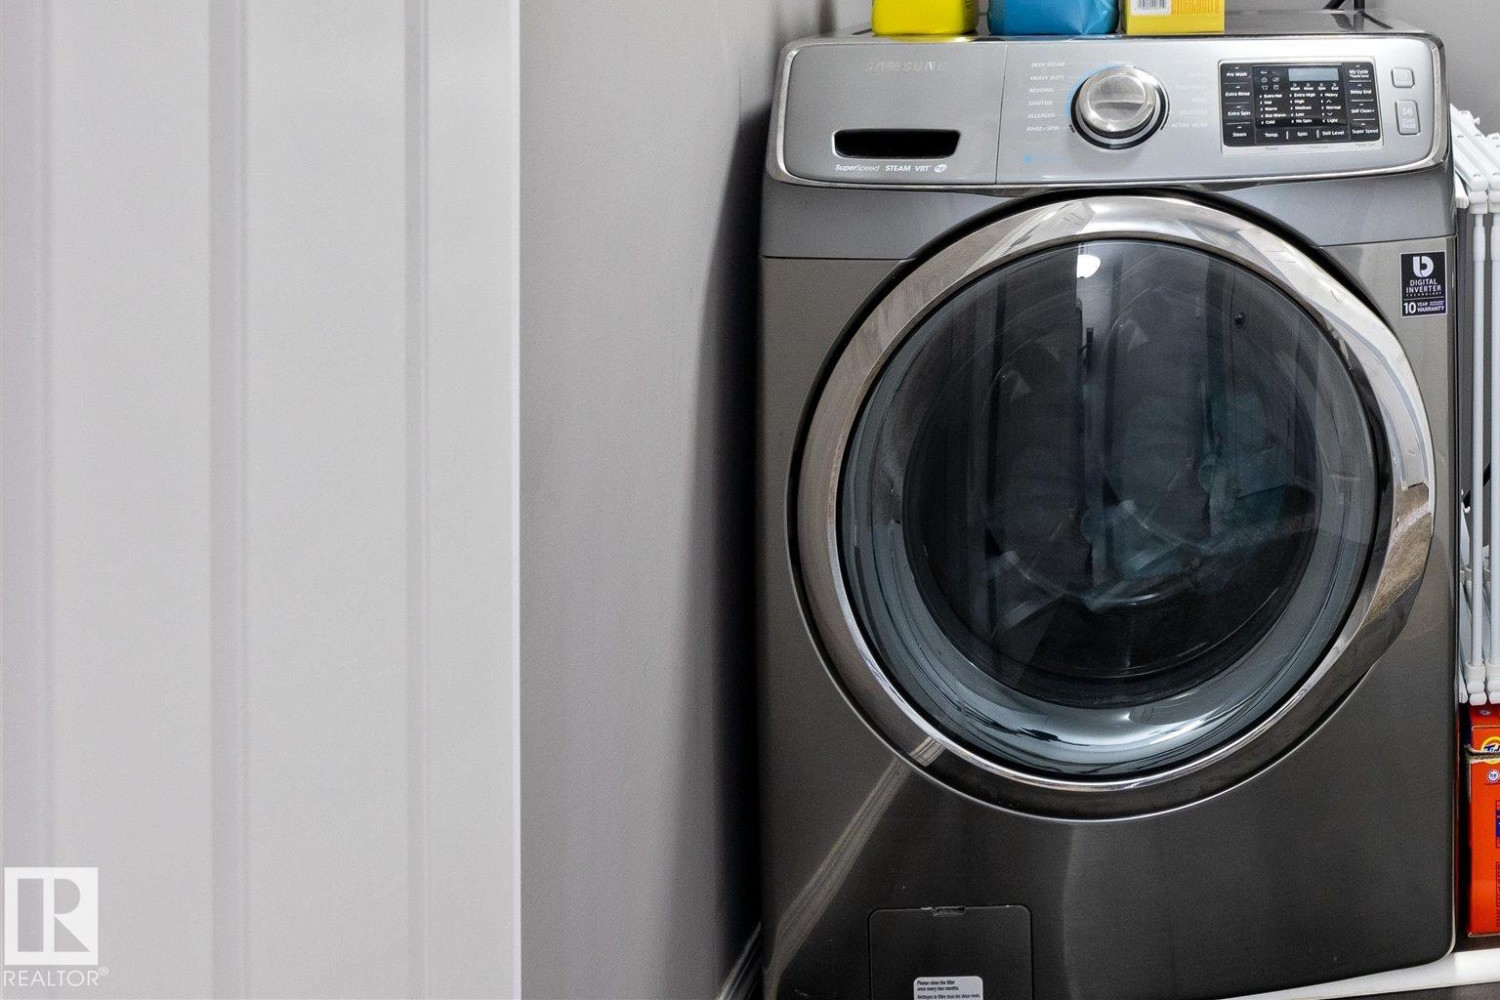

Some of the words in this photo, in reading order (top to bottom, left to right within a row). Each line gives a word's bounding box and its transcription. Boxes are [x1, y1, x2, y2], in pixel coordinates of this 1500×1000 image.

[835, 164, 880, 172] SuperSpeed
[1405, 285, 1442, 293] INVERTER
[1403, 302, 1417, 314] 10
